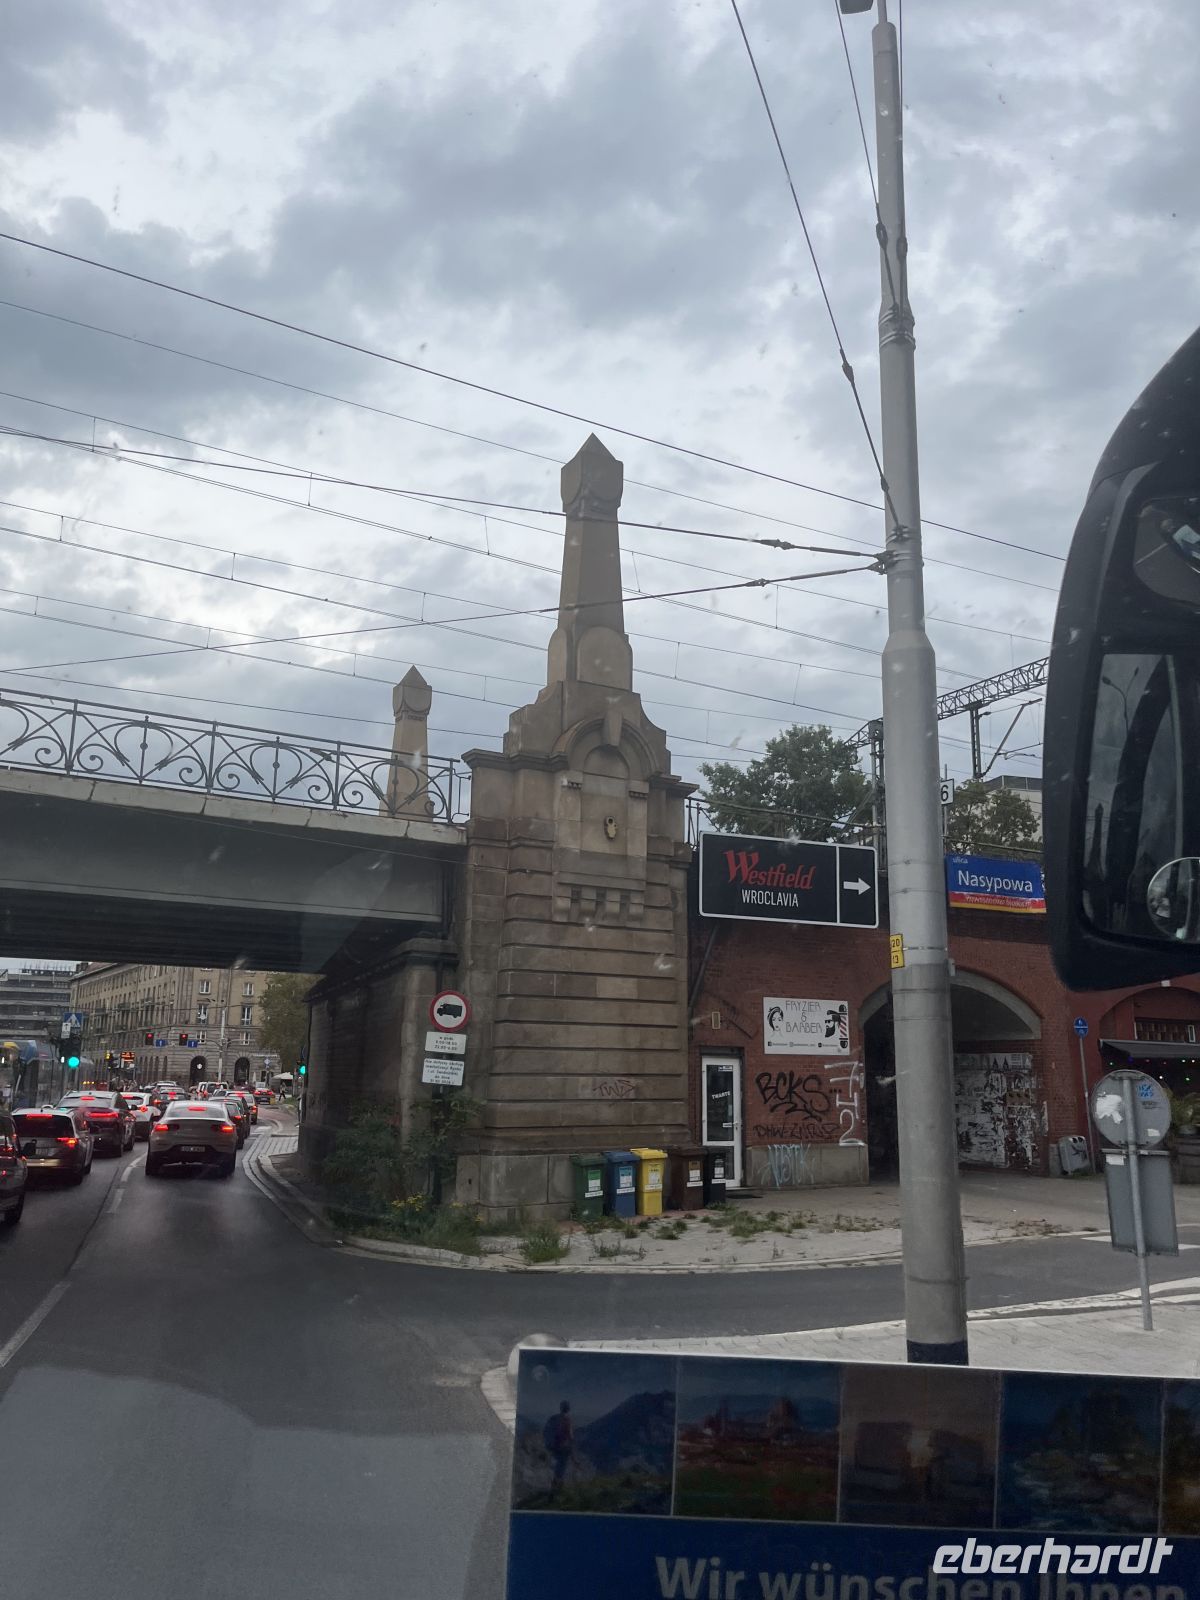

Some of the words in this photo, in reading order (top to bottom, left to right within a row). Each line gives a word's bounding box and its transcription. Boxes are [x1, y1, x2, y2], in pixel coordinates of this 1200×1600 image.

[941, 785, 949, 801] 6
[723, 850, 817, 889] Westfield
[958, 870, 1033, 893] Nasypowa
[742, 889, 799, 908] WROCLAVIA
[891, 938, 900, 947] 20
[786, 1022, 822, 1033] BARBER
[655, 1556, 746, 1600] Wir
[757, 1561, 1021, 1600] wünschen
